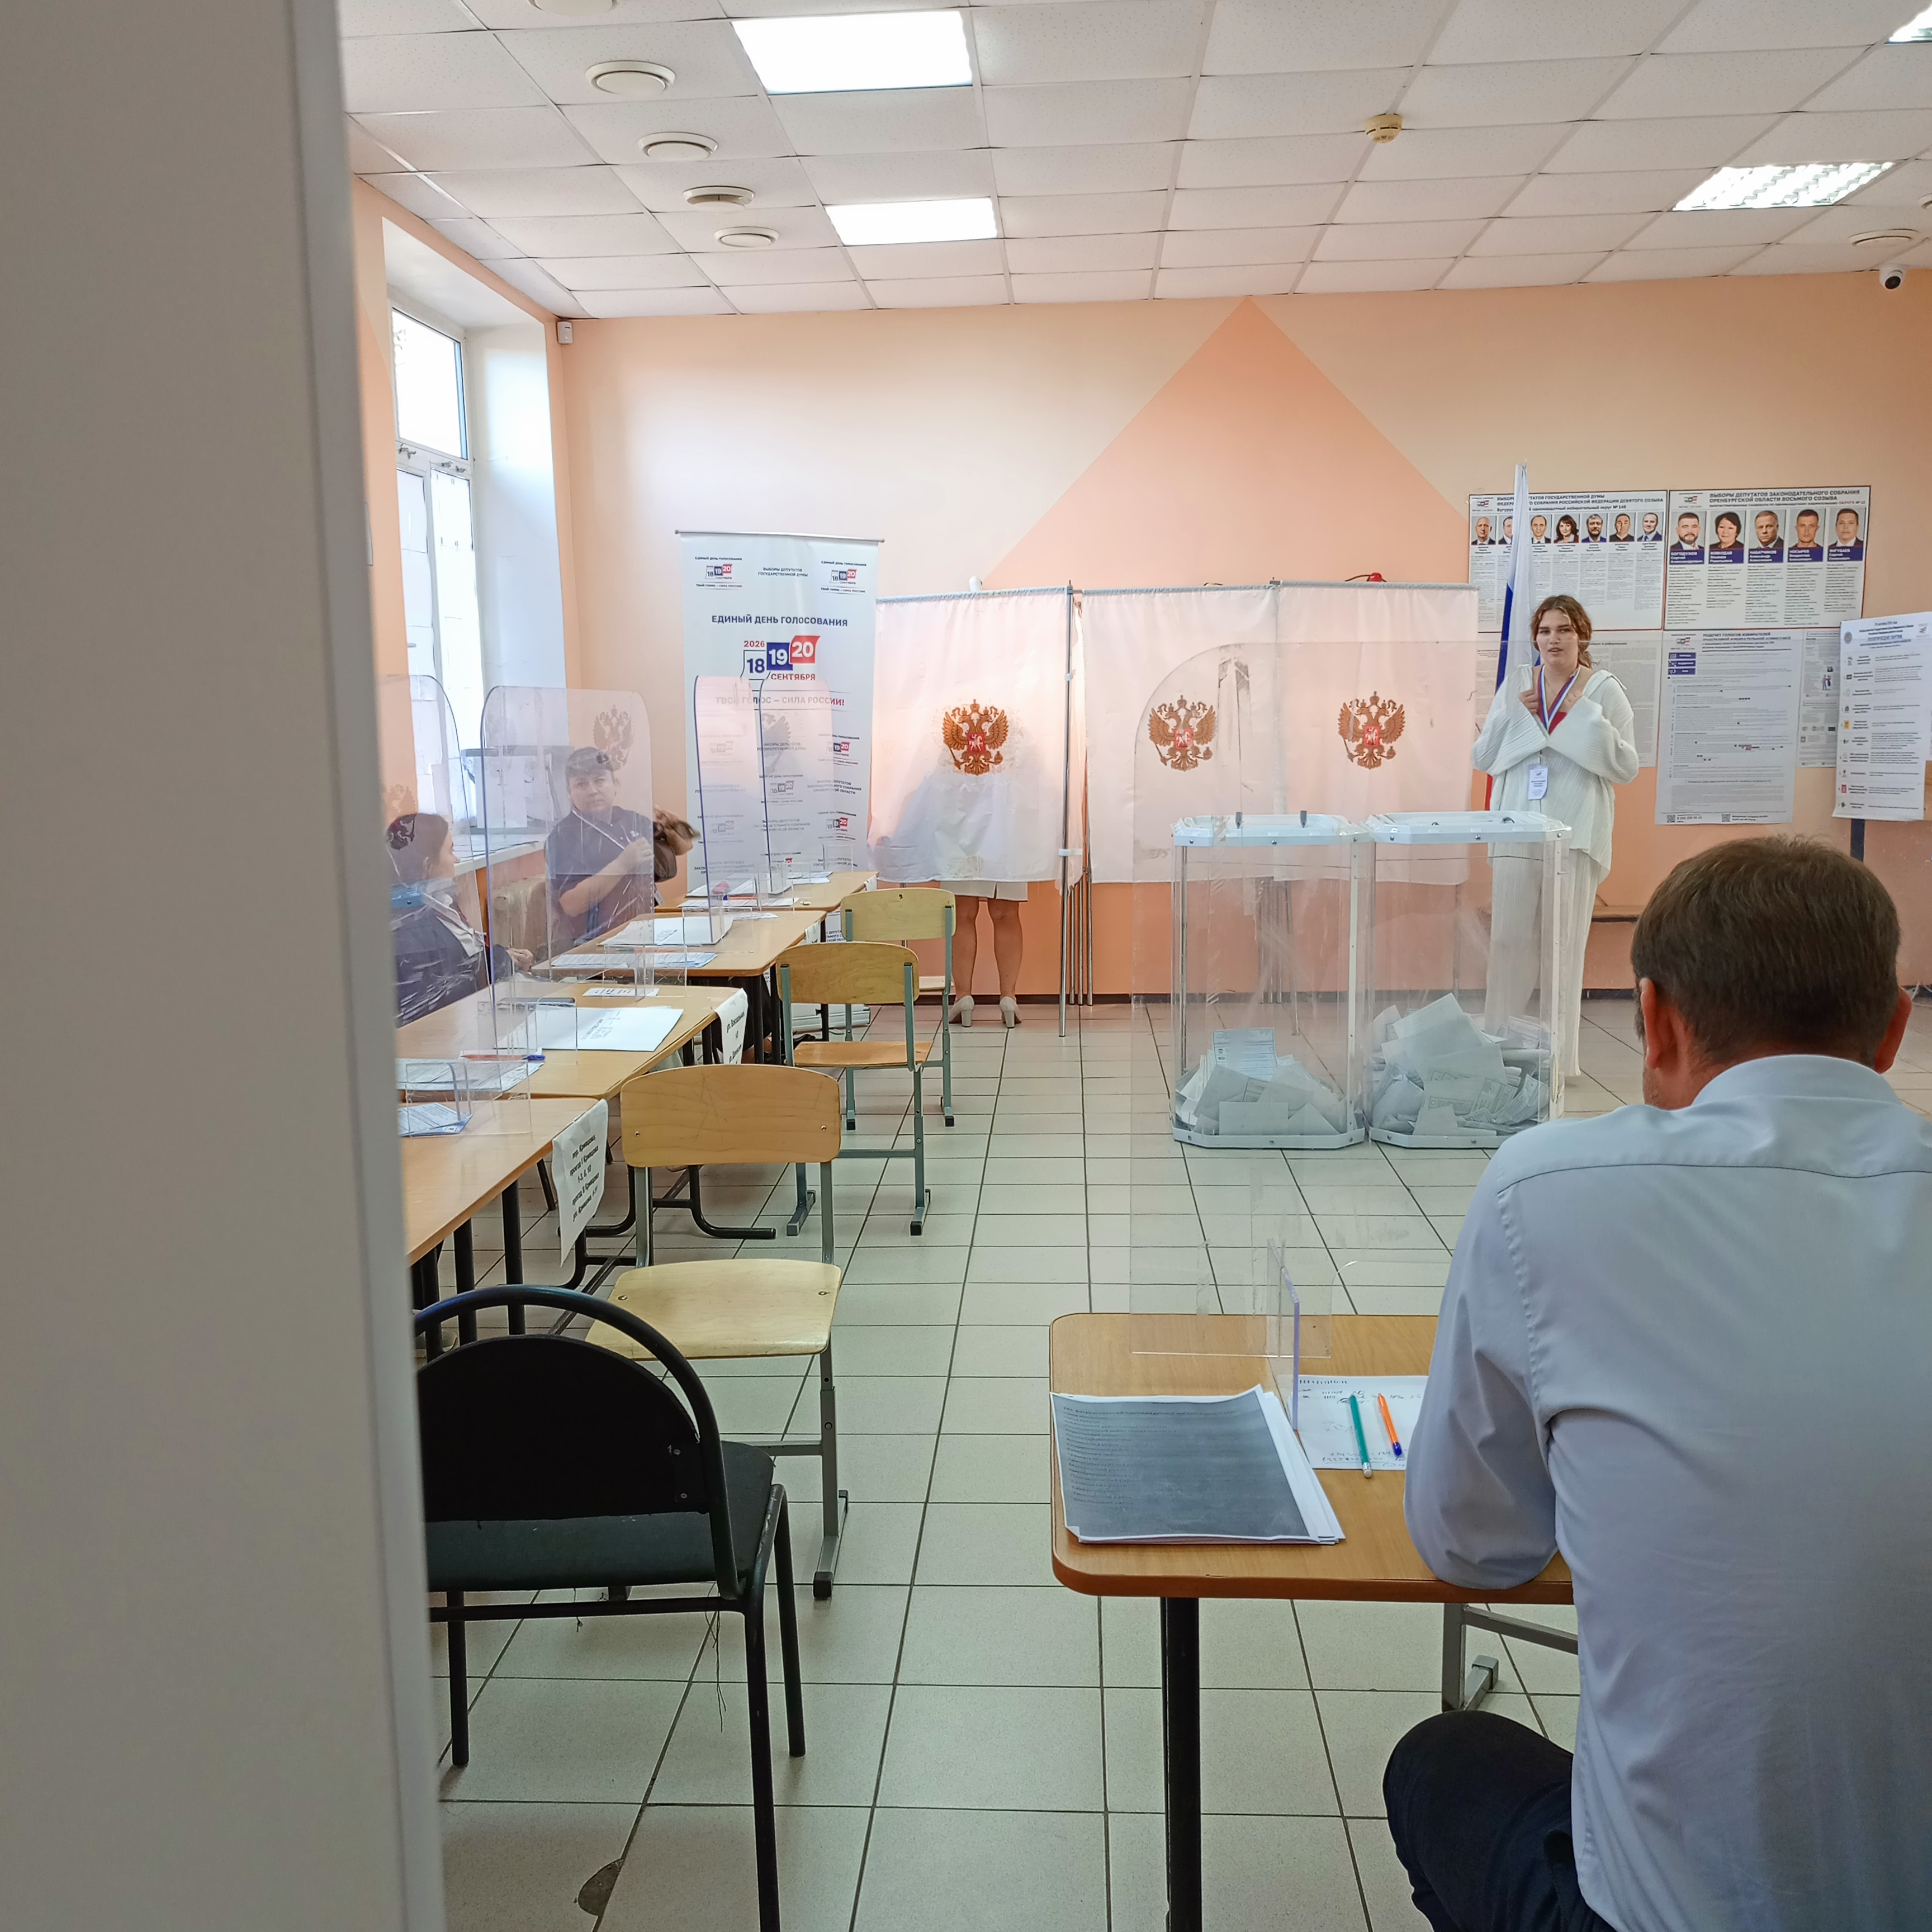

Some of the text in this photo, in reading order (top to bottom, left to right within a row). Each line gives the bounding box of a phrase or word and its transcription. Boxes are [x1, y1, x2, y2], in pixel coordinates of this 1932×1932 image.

[712, 614, 848, 627] ЕДИНЫЙ ДЕНЬ ГОЛОСОВАНИЯ
[746, 641, 814, 674] 18 19 20
[808, 697, 845, 706] РОССИИ!
[579, 1135, 595, 1152] Кривцова
[583, 1145, 599, 1163] Кривцова
[585, 1172, 599, 1191] Кривцова
[578, 1195, 592, 1214] Кривцова
